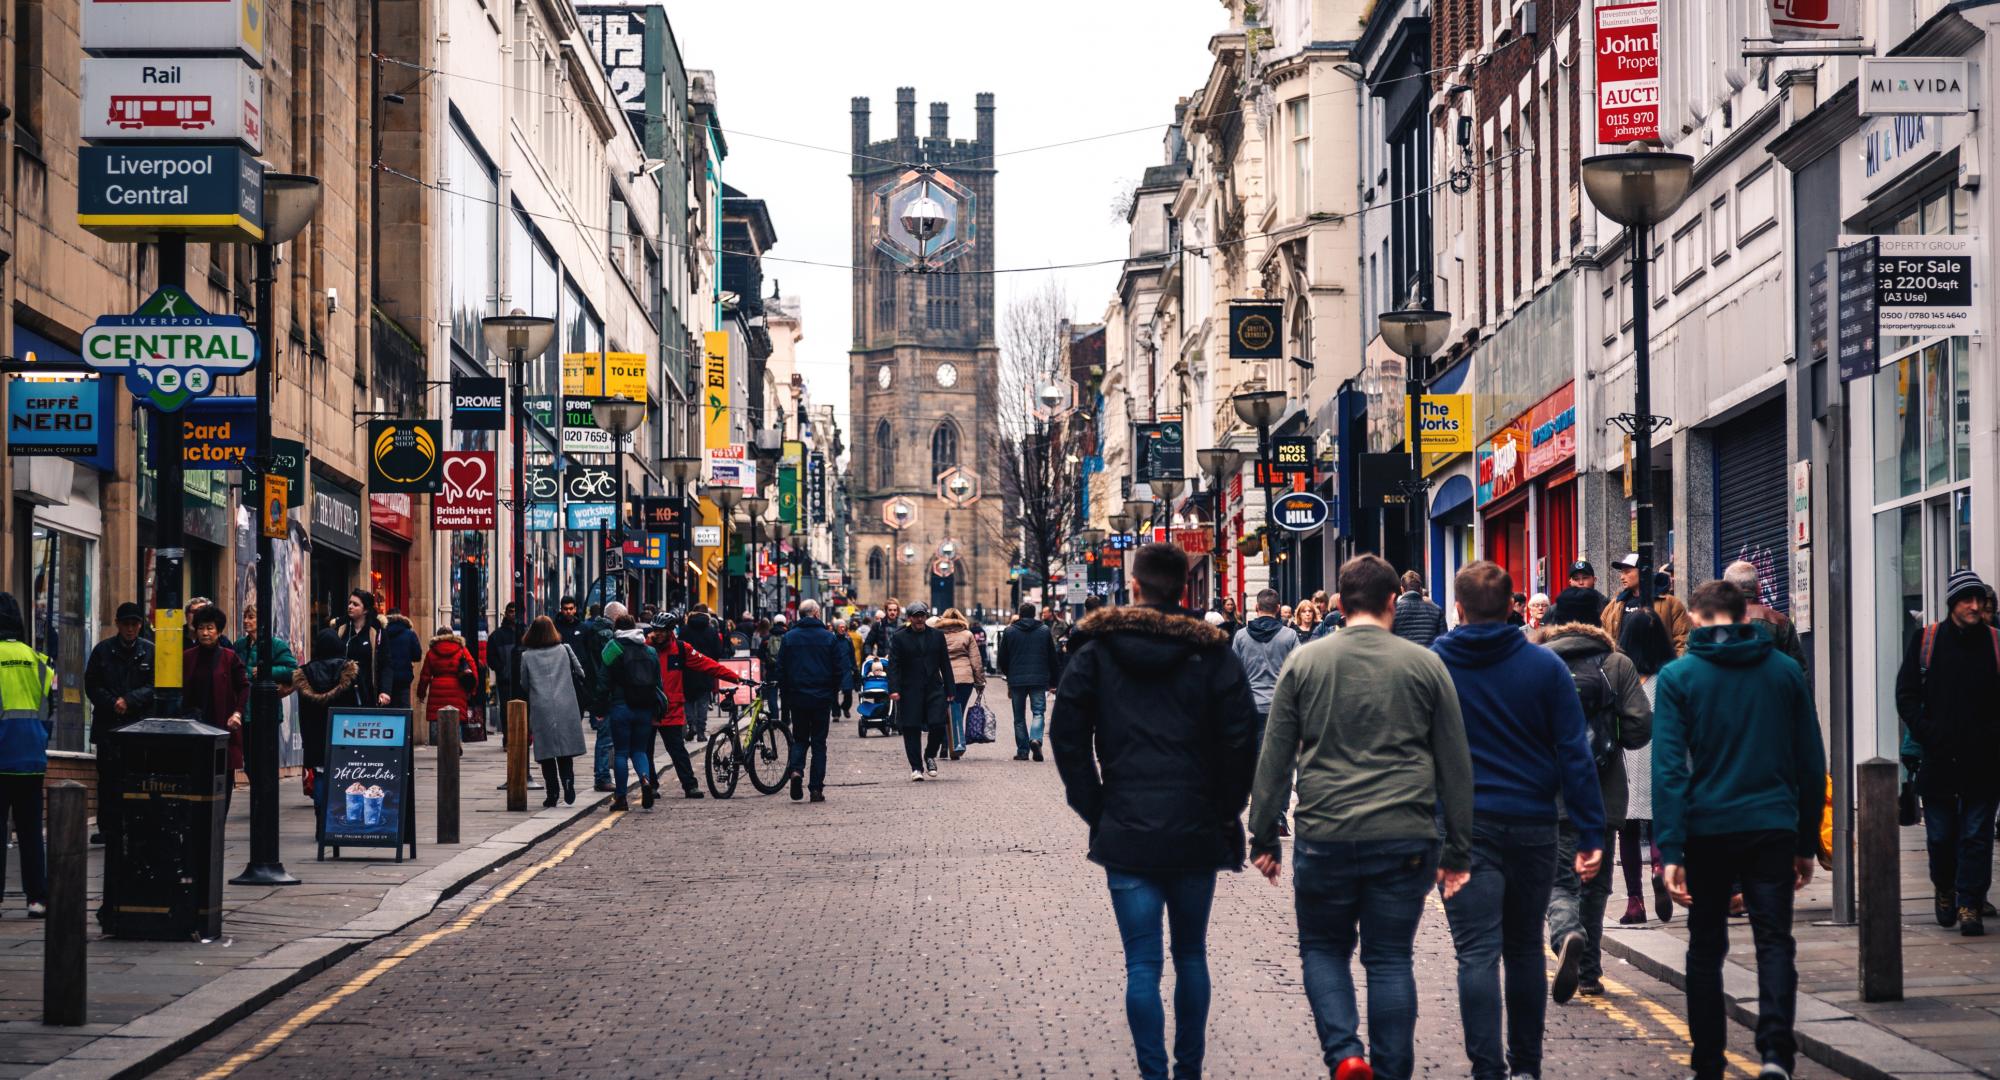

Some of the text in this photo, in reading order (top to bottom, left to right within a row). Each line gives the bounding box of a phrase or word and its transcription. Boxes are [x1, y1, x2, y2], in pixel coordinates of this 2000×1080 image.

[1602, 10, 1638, 18] Investment
[1600, 34, 1649, 55] John
[142, 66, 181, 84] Rail
[1870, 78, 1961, 92] MI VIDA
[1606, 112, 1654, 126] 0115 970
[106, 155, 213, 178] Liverpool
[106, 185, 189, 205] Central
[1880, 242, 1966, 250] ROPERTY GROUP
[1879, 262, 1894, 273] se
[1898, 261, 1924, 273] For
[1927, 260, 1961, 273] Sale
[1884, 292, 1928, 303] (A3 Use)
[89, 334, 249, 360] CENTRAL
[611, 367, 645, 377] TO LET
[455, 396, 502, 407] DROME
[566, 400, 592, 411] green
[1420, 401, 1449, 415] The
[12, 413, 92, 431] NERO
[567, 413, 595, 425] TO LE
[183, 422, 231, 439] Card
[565, 431, 582, 442] 020
[585, 431, 608, 442] 7659
[1279, 445, 1306, 453] MOSS
[1279, 454, 1308, 462] BROS.
[437, 507, 492, 515] British Heart
[574, 506, 615, 518] workshop
[1286, 510, 1315, 524] HILL
[343, 729, 394, 739] NERO
[334, 767, 396, 780] Hot Chocolates
[142, 780, 177, 793] Litter
